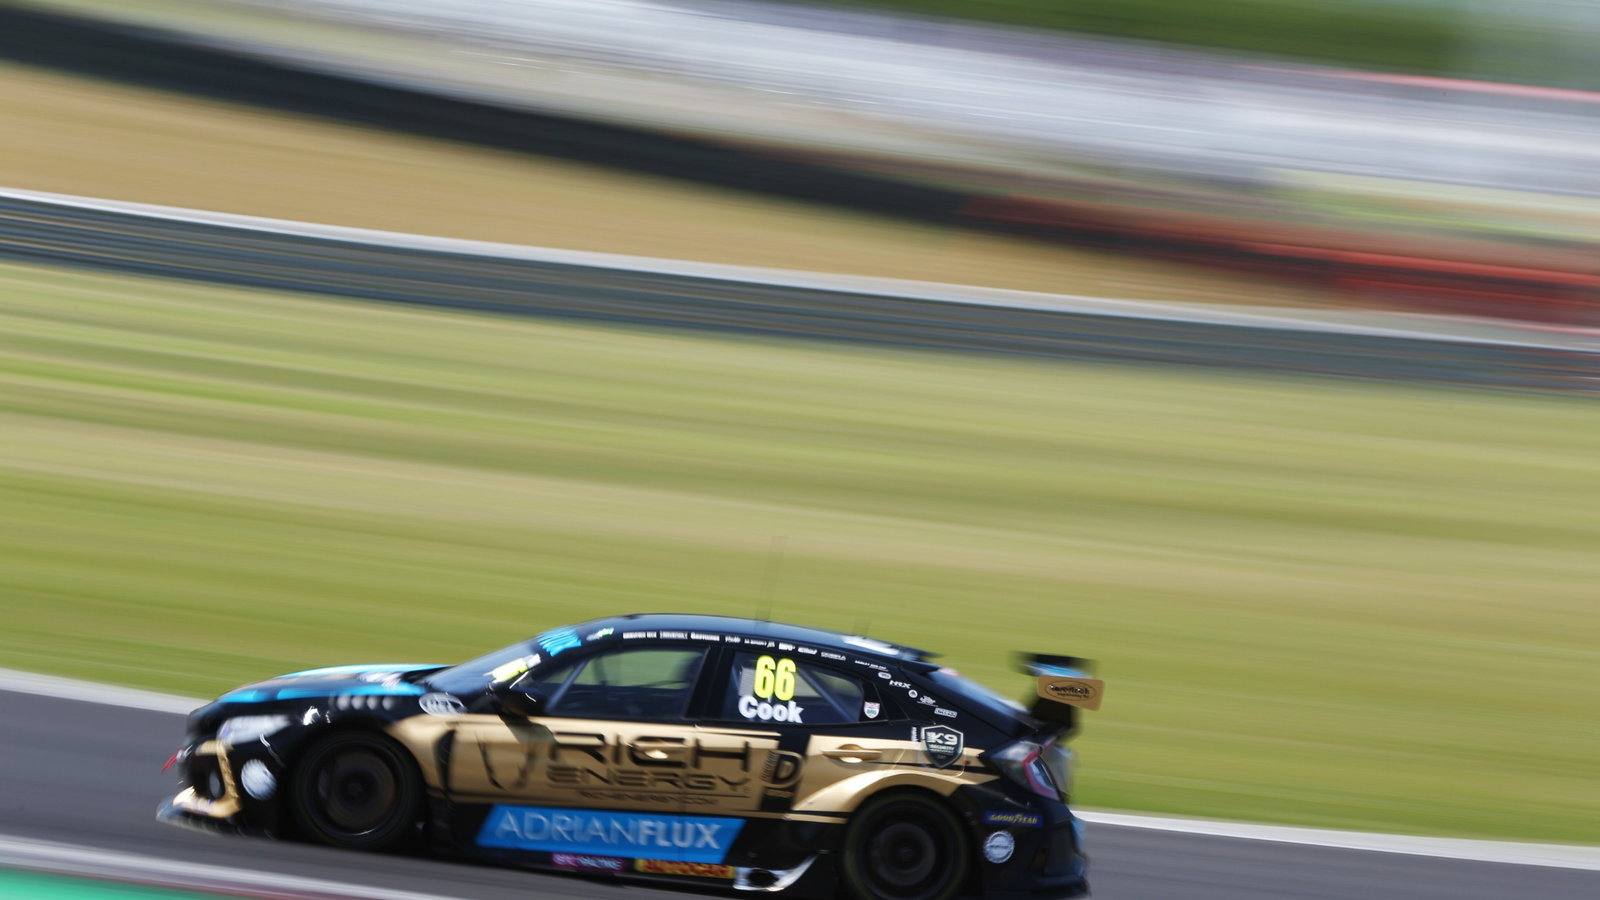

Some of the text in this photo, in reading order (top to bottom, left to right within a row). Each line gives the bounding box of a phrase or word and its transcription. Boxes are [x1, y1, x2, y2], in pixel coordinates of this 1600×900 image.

[754, 655, 796, 701] 66
[738, 695, 804, 723] Cook
[549, 730, 749, 773] RICH
[926, 731, 958, 745] K9
[547, 765, 751, 791] ENERGY
